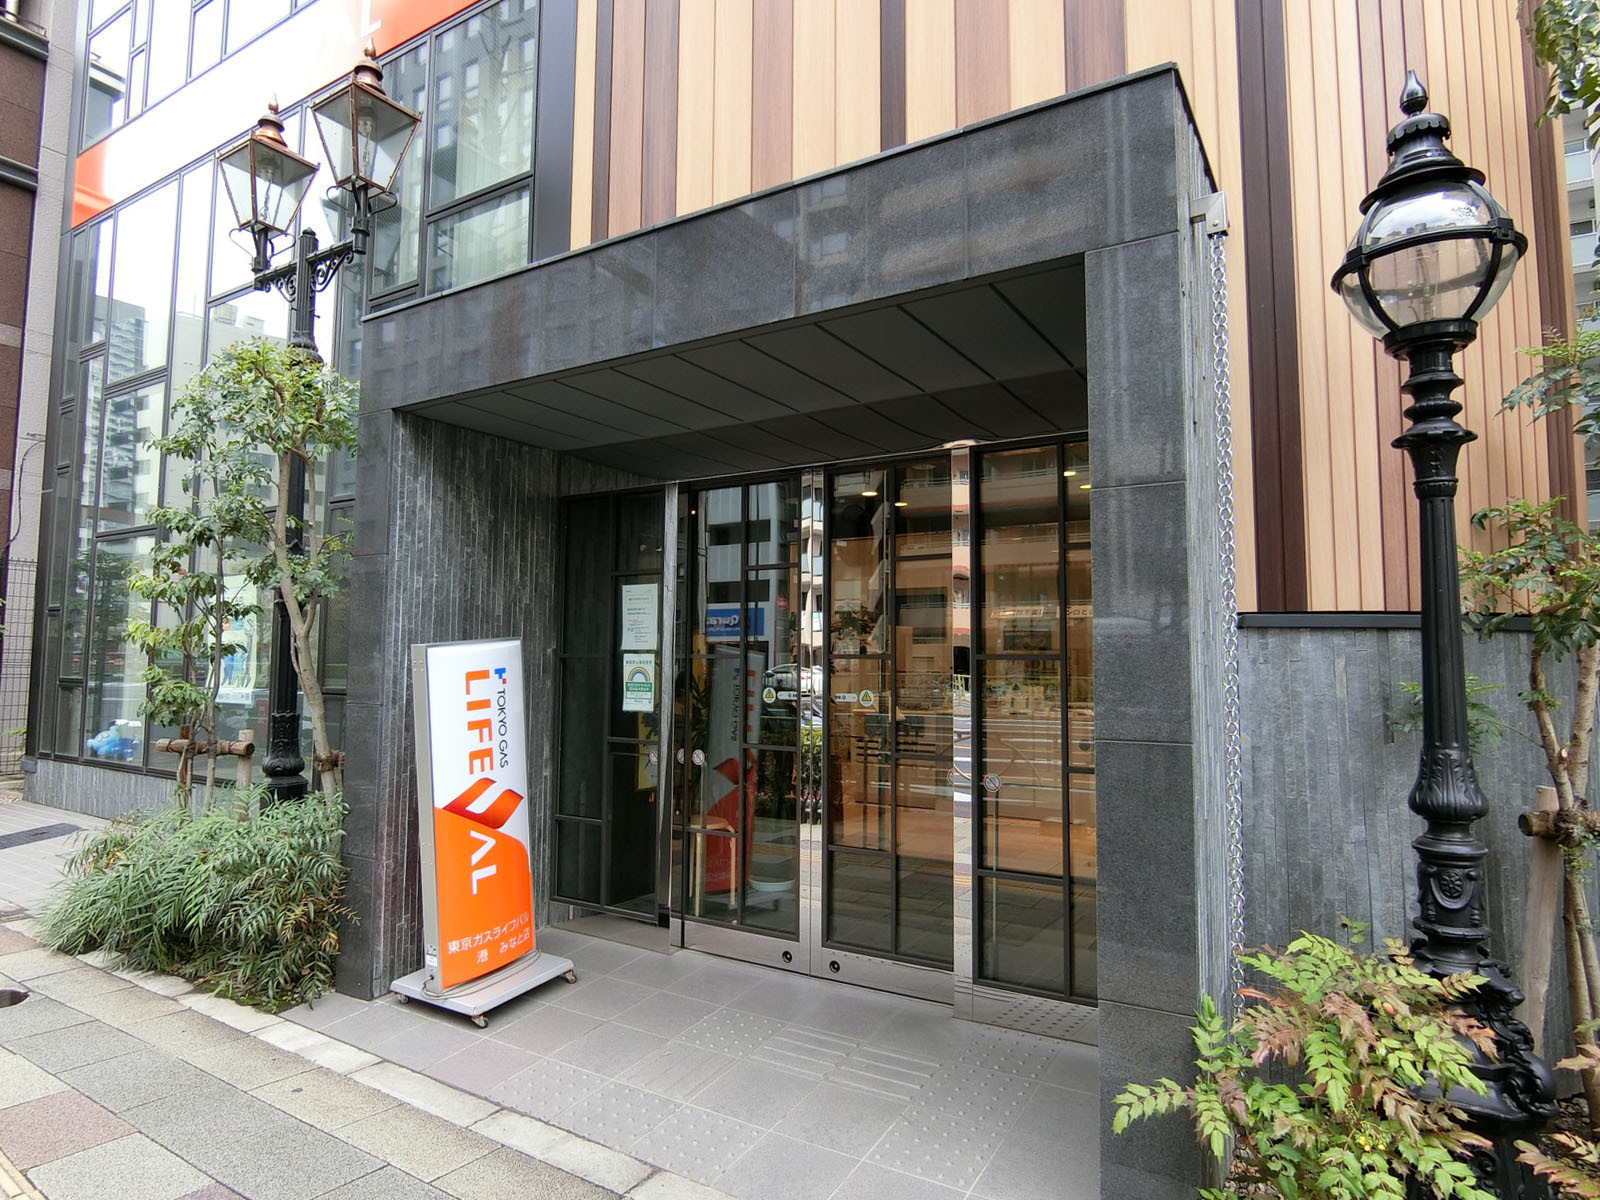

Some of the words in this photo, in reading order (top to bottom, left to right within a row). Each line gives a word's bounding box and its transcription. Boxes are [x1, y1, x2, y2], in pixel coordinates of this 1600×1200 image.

[497, 688, 508, 736] TOKYO
[499, 740, 508, 768] GAS
[447, 912, 529, 955] 東京ガスライフバル
